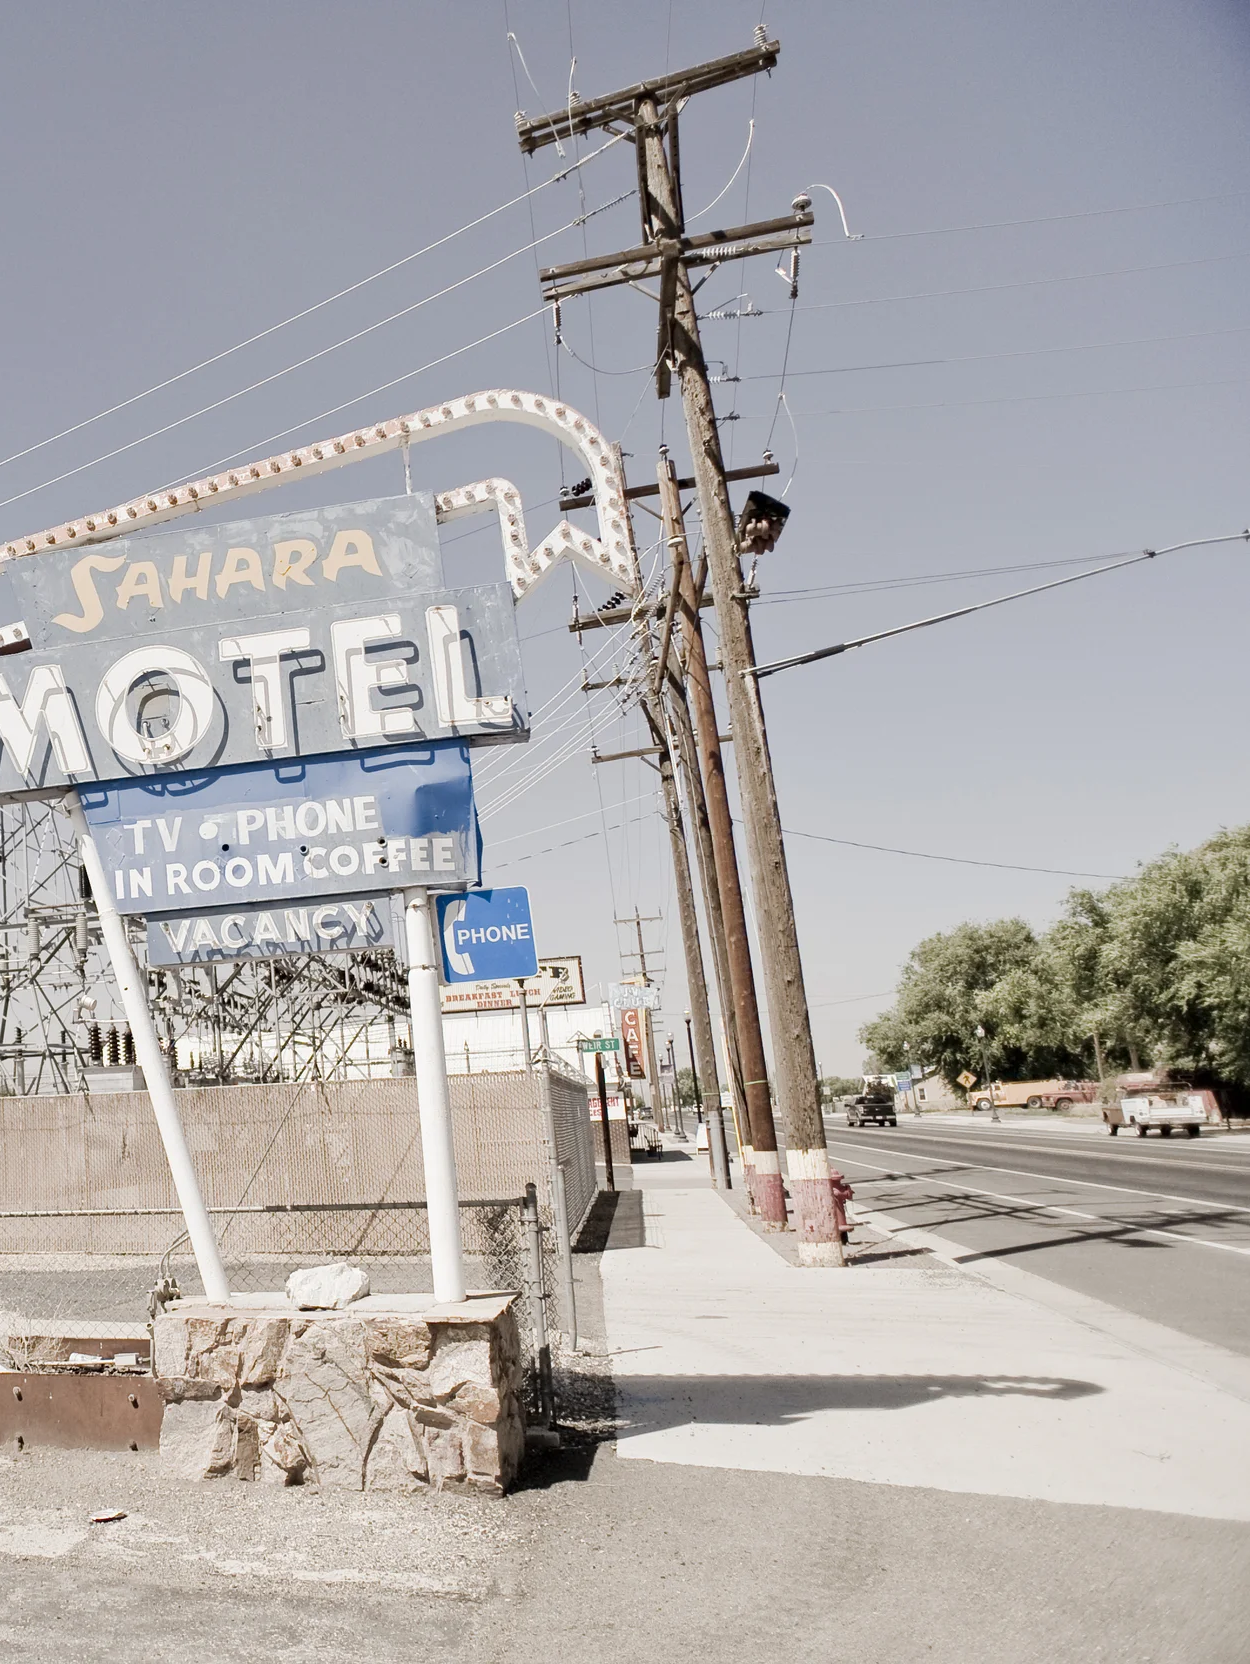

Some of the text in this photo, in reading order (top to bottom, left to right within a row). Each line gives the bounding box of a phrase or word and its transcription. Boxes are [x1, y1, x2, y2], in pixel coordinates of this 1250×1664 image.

[50, 529, 383, 633] SAHARA
[123, 796, 379, 855] TV PHONE
[114, 838, 456, 899] IN ROOM COFFEE
[159, 901, 376, 953] VACANCY
[457, 923, 530, 945] PHONE
[445, 991, 503, 1003] BREAKFAST
[477, 999, 513, 1008] DINNER
[582, 1040, 615, 1050] WEIR ST
[624, 1011, 642, 1076] CAFE
